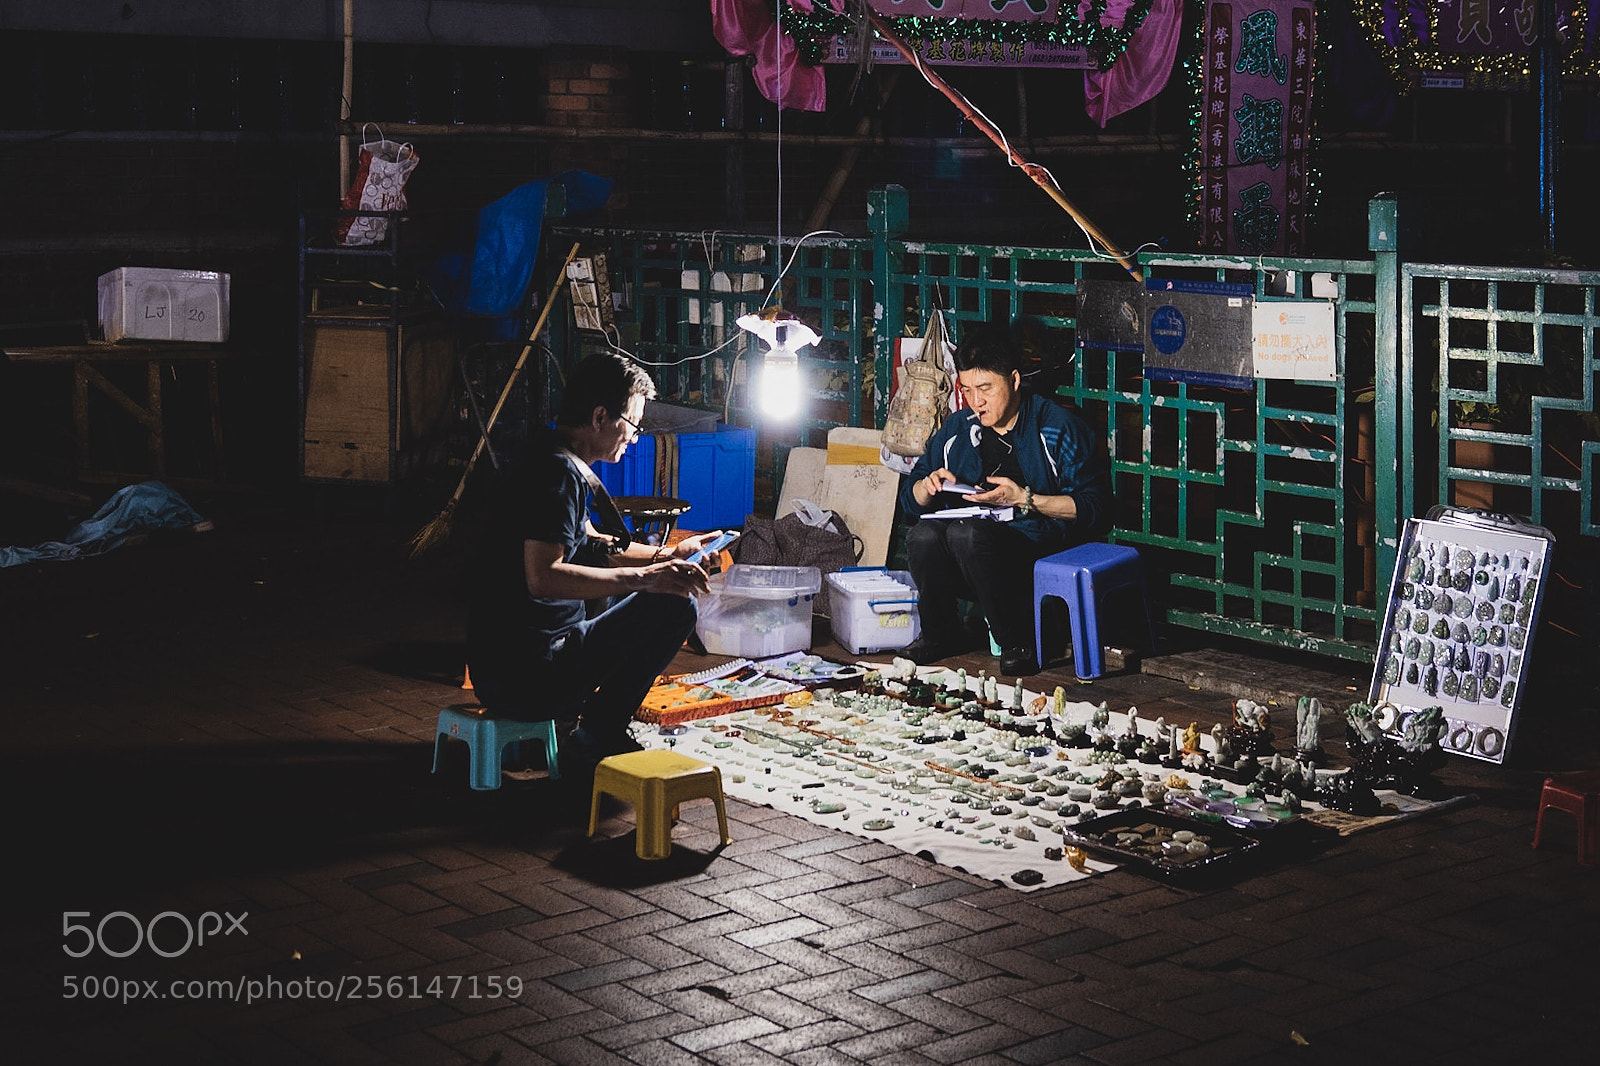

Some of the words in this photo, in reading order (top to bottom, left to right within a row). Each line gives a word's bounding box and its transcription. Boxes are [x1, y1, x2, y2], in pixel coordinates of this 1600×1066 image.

[145, 305, 167, 319] LJ
[188, 308, 206, 322] 20
[1258, 352, 1270, 360] No
[1272, 353, 1291, 363] dogs
